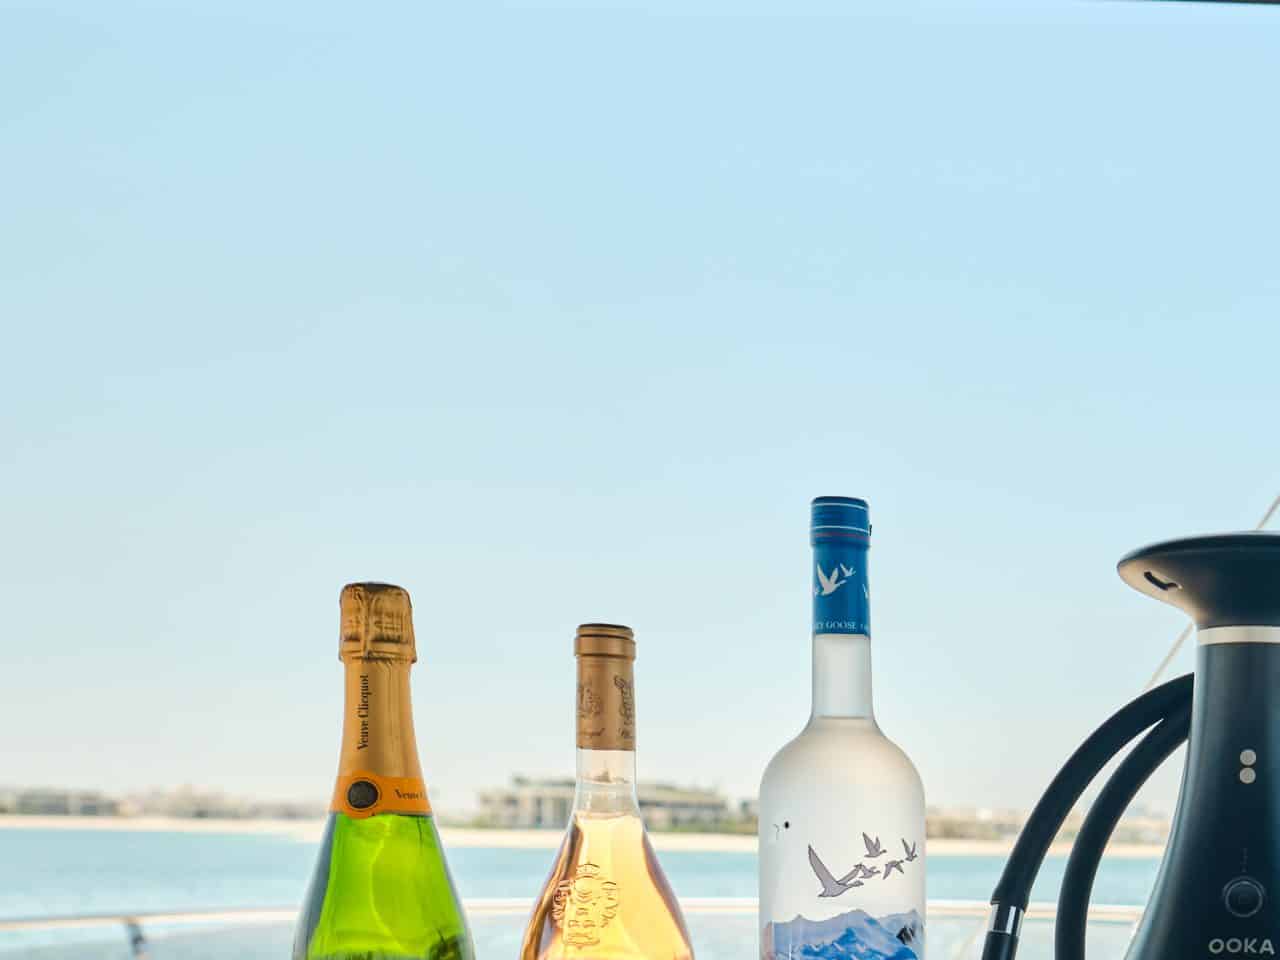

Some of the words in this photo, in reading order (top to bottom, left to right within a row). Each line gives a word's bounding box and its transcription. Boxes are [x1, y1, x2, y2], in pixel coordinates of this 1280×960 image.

[357, 674, 372, 718] Clicquot
[357, 720, 369, 750] Veuve
[1208, 938, 1275, 955] OOKA
